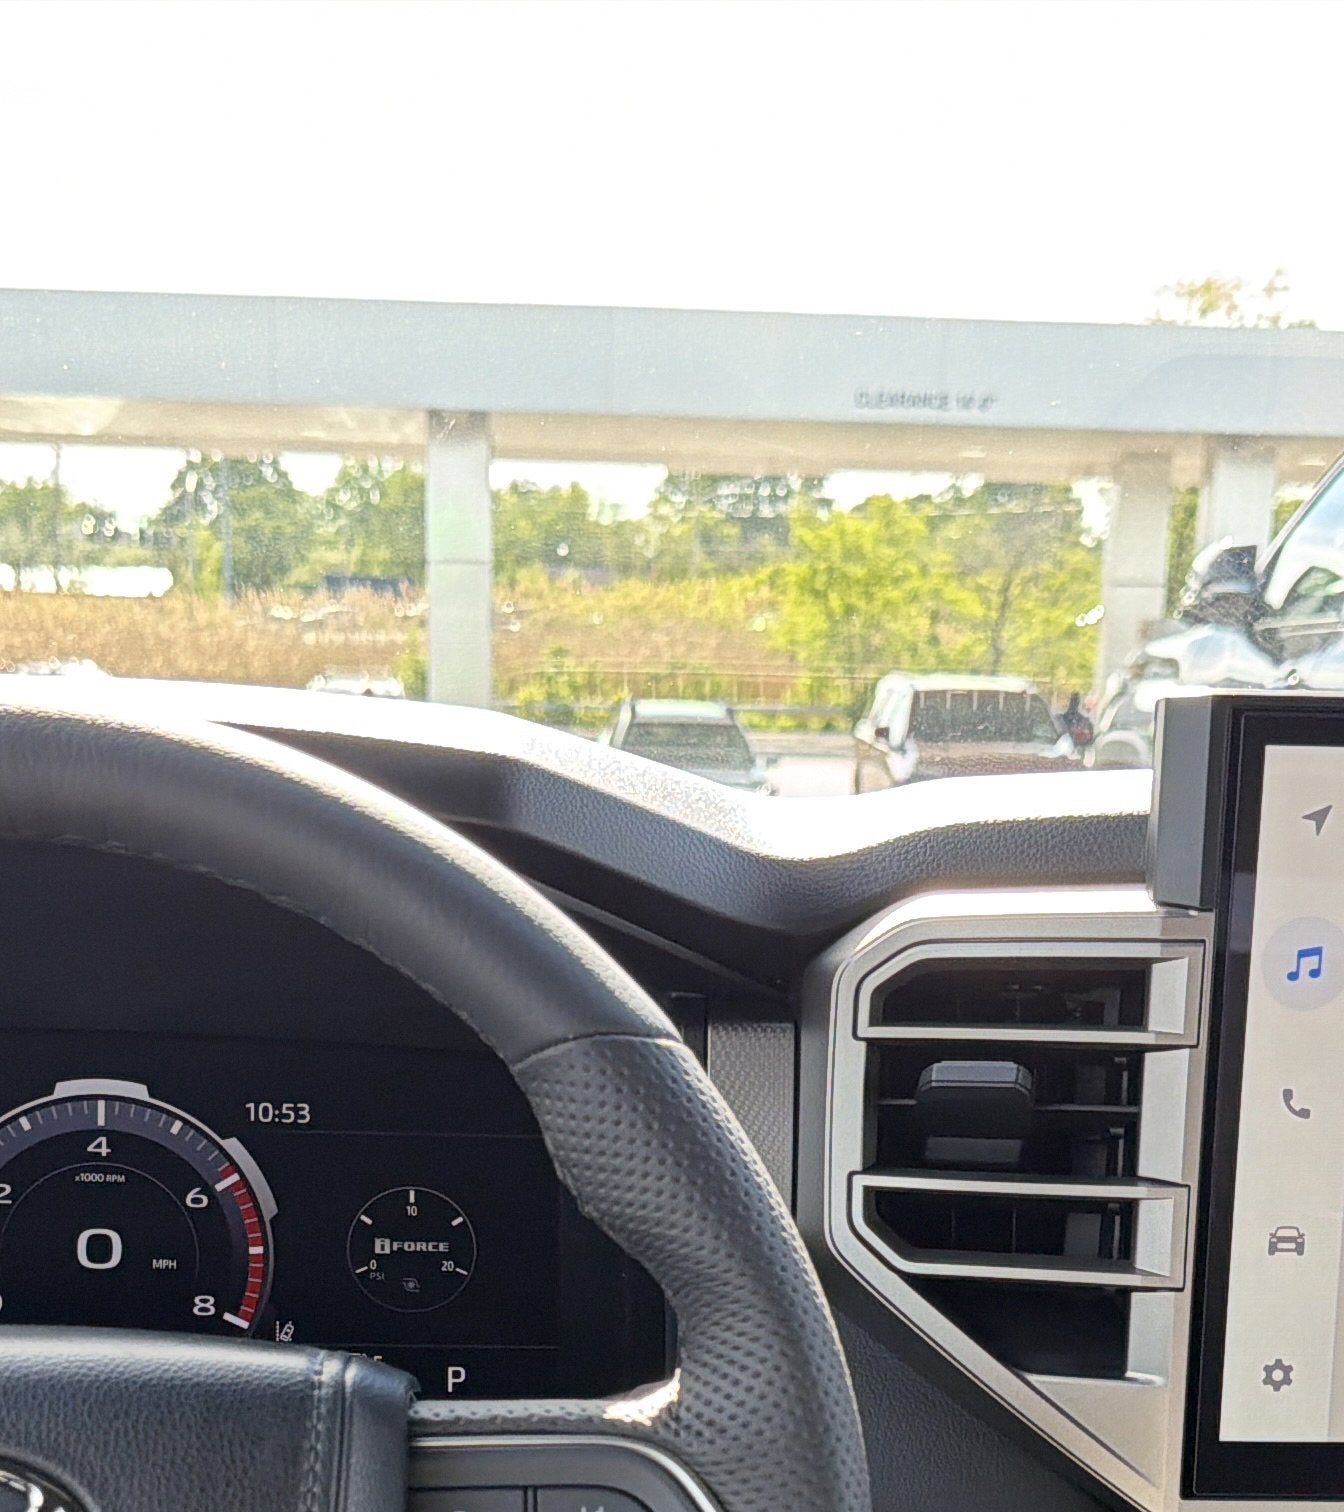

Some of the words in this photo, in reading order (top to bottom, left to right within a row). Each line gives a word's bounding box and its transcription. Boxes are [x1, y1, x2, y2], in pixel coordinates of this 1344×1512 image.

[245, 1102, 311, 1124] 10:53
[87, 1136, 112, 1157] 4
[106, 1173, 126, 1184] RPM
[185, 1188, 209, 1209] 6
[406, 1206, 418, 1217] 10
[76, 1228, 123, 1270] 0
[152, 1258, 177, 1270] MPH
[441, 1261, 454, 1272] 20
[193, 1295, 216, 1317] 8
[447, 1366, 466, 1394] P
